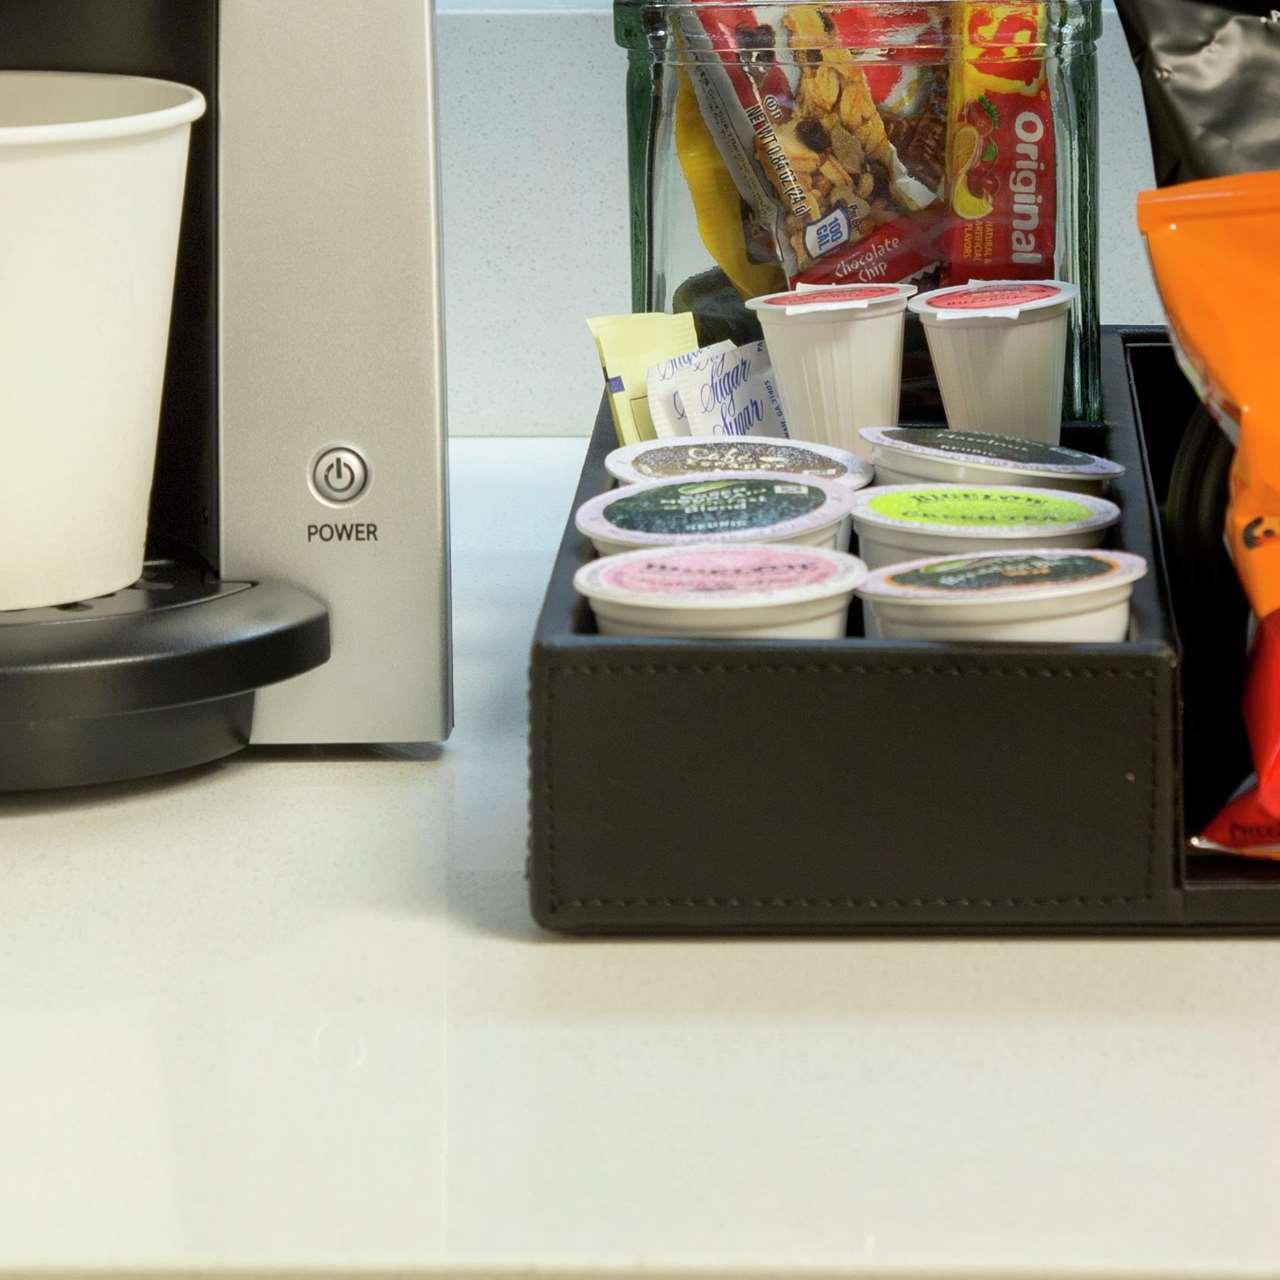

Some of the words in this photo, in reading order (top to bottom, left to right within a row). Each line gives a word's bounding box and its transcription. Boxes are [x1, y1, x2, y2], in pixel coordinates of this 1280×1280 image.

[1009, 111, 1044, 264] Original
[816, 224, 829, 250] CAL
[830, 216, 844, 243] 100
[835, 237, 901, 278] Chocolate
[858, 261, 888, 283] Chip
[700, 357, 751, 417] Sugar
[307, 523, 378, 542] POWER
